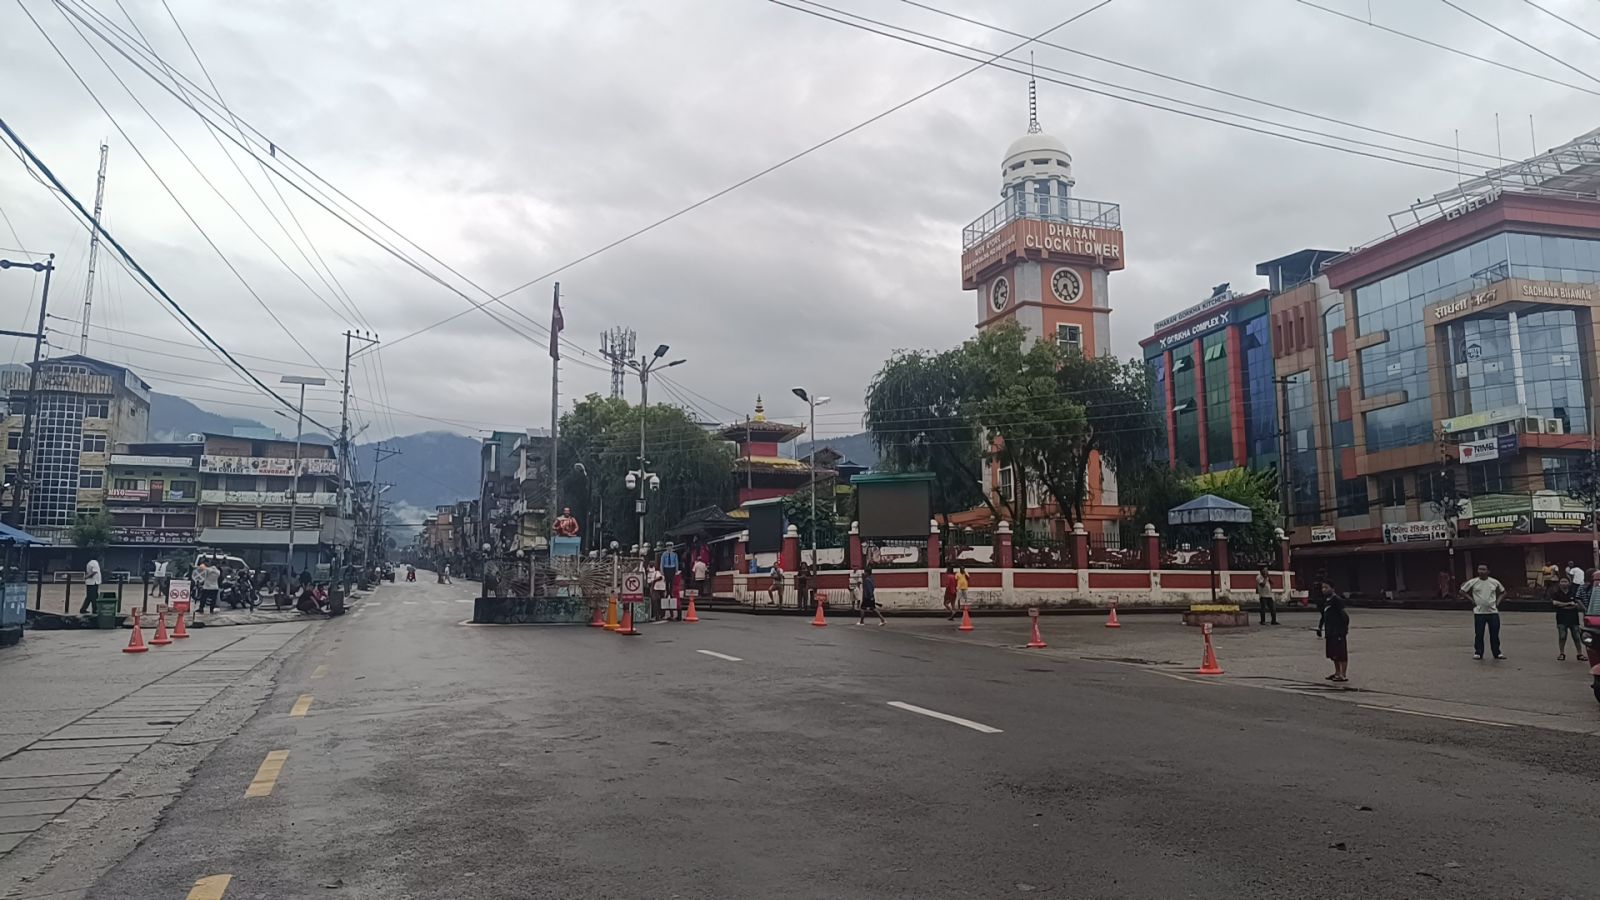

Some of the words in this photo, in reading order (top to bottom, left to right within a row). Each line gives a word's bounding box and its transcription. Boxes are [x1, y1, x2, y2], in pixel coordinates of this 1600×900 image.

[1485, 187, 1503, 205] UP
[1049, 224, 1096, 241] DHARAN
[1025, 234, 1071, 251] CLOCK
[1076, 241, 1120, 258] TOWER
[1522, 285, 1559, 298] SADHANA
[1560, 287, 1592, 301] BHAWAN
[1155, 315, 1177, 330] DHARAN
[1178, 305, 1201, 320] GORKHA
[1202, 294, 1227, 310] KITCHEN
[1166, 328, 1191, 345] GORKHA
[1192, 316, 1219, 335] COMPLEX
[1496, 514, 1519, 523] FEVER
[1533, 511, 1564, 520] FASHION
[1564, 512, 1586, 521] FEVER
